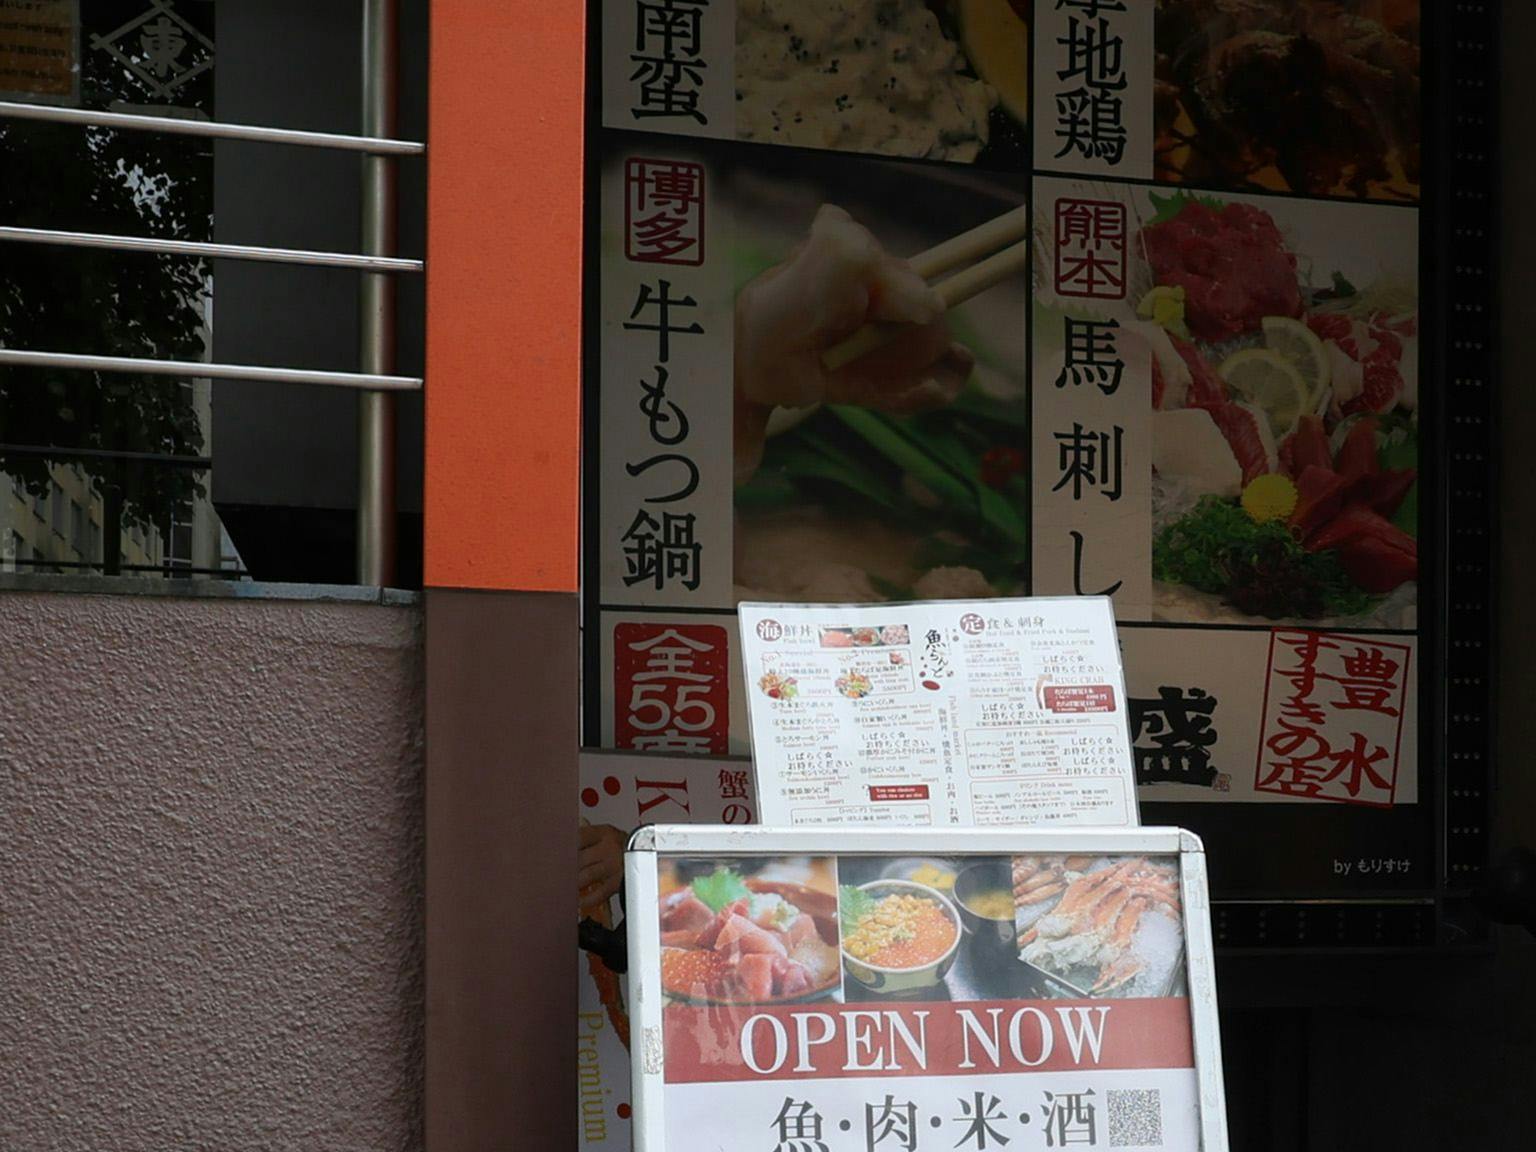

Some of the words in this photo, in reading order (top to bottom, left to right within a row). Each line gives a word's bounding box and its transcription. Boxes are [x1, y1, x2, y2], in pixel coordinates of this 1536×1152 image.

[629, 162, 702, 264] 博多
[1058, 204, 1122, 296] 熊本
[621, 280, 705, 593] 牛もつ鍋
[1052, 316, 1125, 597] 馬刺し
[1054, 676, 1078, 684] KING
[1258, 632, 1340, 797] すすきの店
[1322, 648, 1400, 798] 豊水
[1333, 860, 1353, 876] by
[1357, 857, 1411, 874] もりすけ
[740, 1009, 930, 1074] OPEN
[957, 1005, 1112, 1070] NOW
